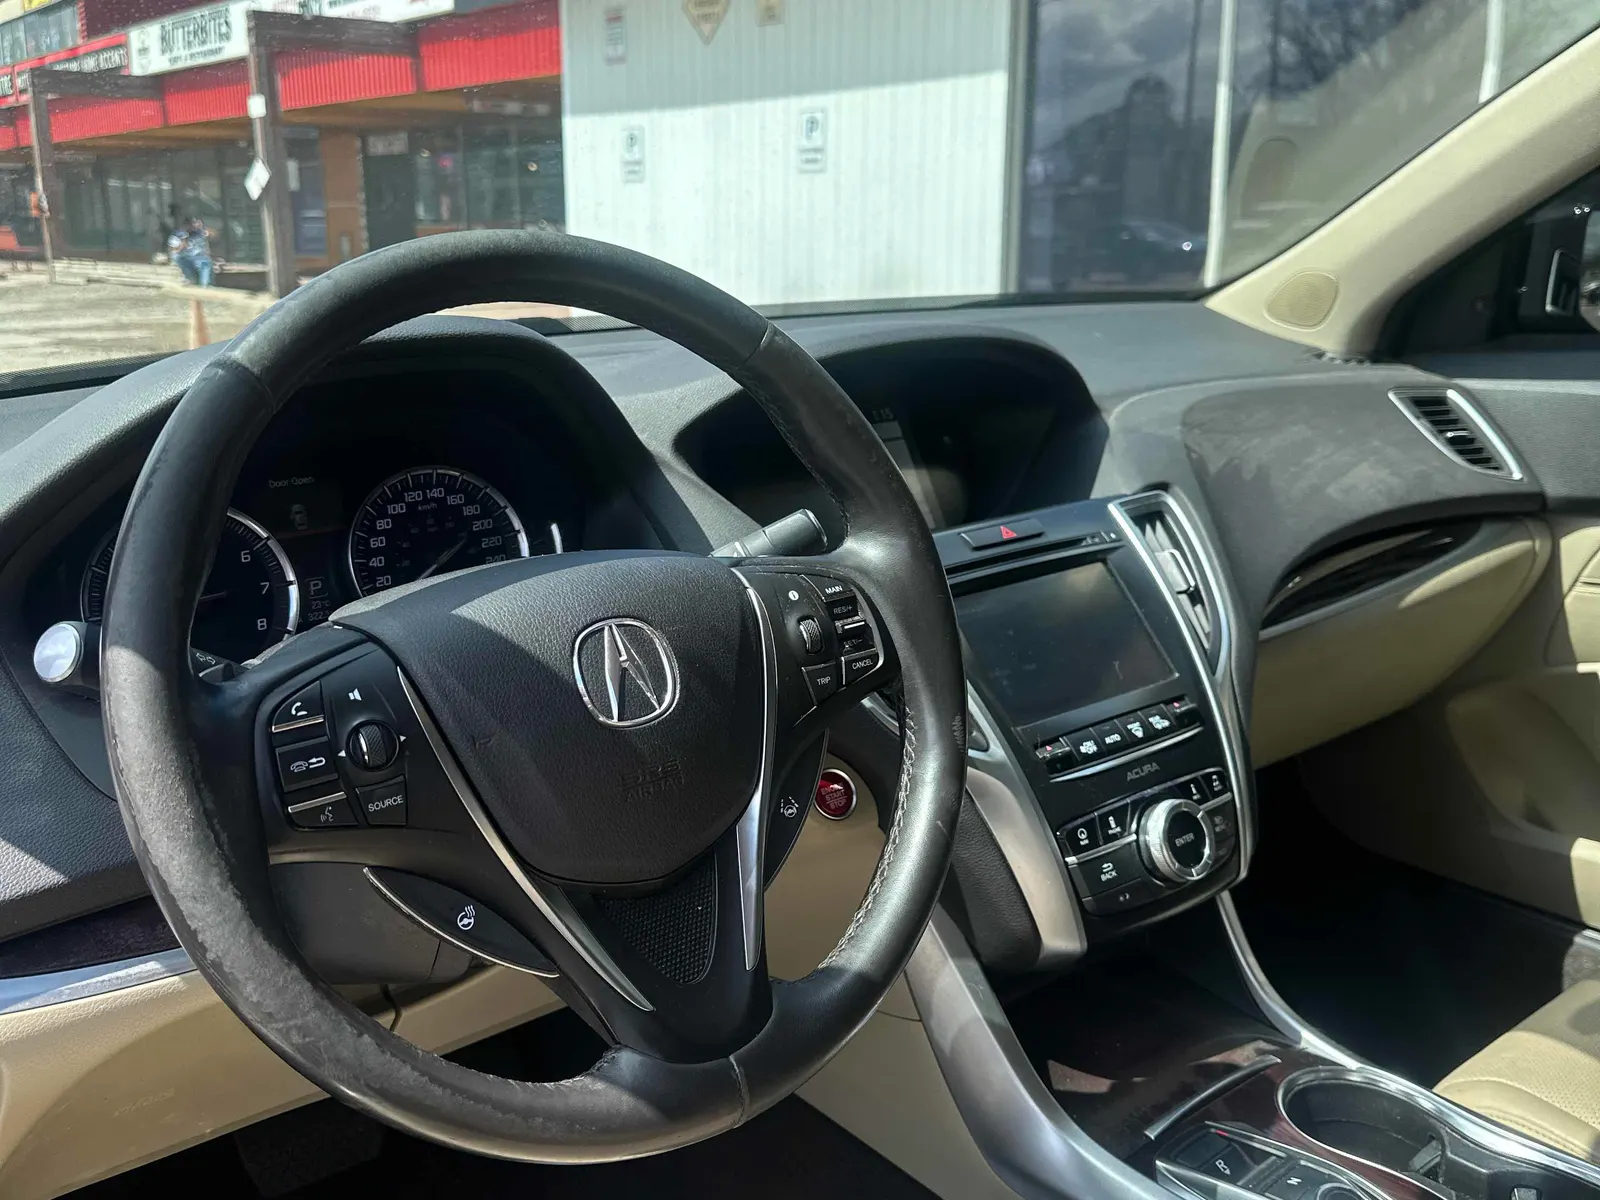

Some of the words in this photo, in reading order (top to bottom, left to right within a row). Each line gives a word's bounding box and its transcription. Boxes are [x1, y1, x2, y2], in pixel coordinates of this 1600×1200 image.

[160, 6, 232, 55] BUTTERBITES
[268, 479, 289, 489] Door
[291, 476, 315, 488] Open
[404, 490, 423, 502] 120
[425, 487, 445, 499] 140
[446, 493, 465, 505] 160
[387, 503, 406, 515] 100
[417, 501, 438, 511] km/h
[462, 504, 481, 516] 180
[376, 518, 392, 530] 80
[472, 518, 493, 531] 200
[370, 536, 386, 548] 60
[481, 536, 503, 548] 220
[241, 551, 250, 562] 6
[369, 556, 385, 568] 40
[376, 575, 392, 587] 20
[260, 582, 270, 594] 7
[310, 580, 322, 595] P
[825, 585, 843, 594] MAIN
[257, 618, 267, 630] 8
[852, 658, 873, 670] CANCEL
[816, 676, 831, 686] TRIP
[1104, 733, 1122, 744] AUTO
[1126, 762, 1160, 781] ACURA
[825, 789, 846, 802] START
[368, 795, 404, 812] SOURCE
[830, 798, 847, 809] STOP
[1175, 833, 1195, 847] ENTER
[1100, 870, 1118, 882] BACK
[1216, 1158, 1227, 1172] R
[1286, 1177, 1302, 1185] N
